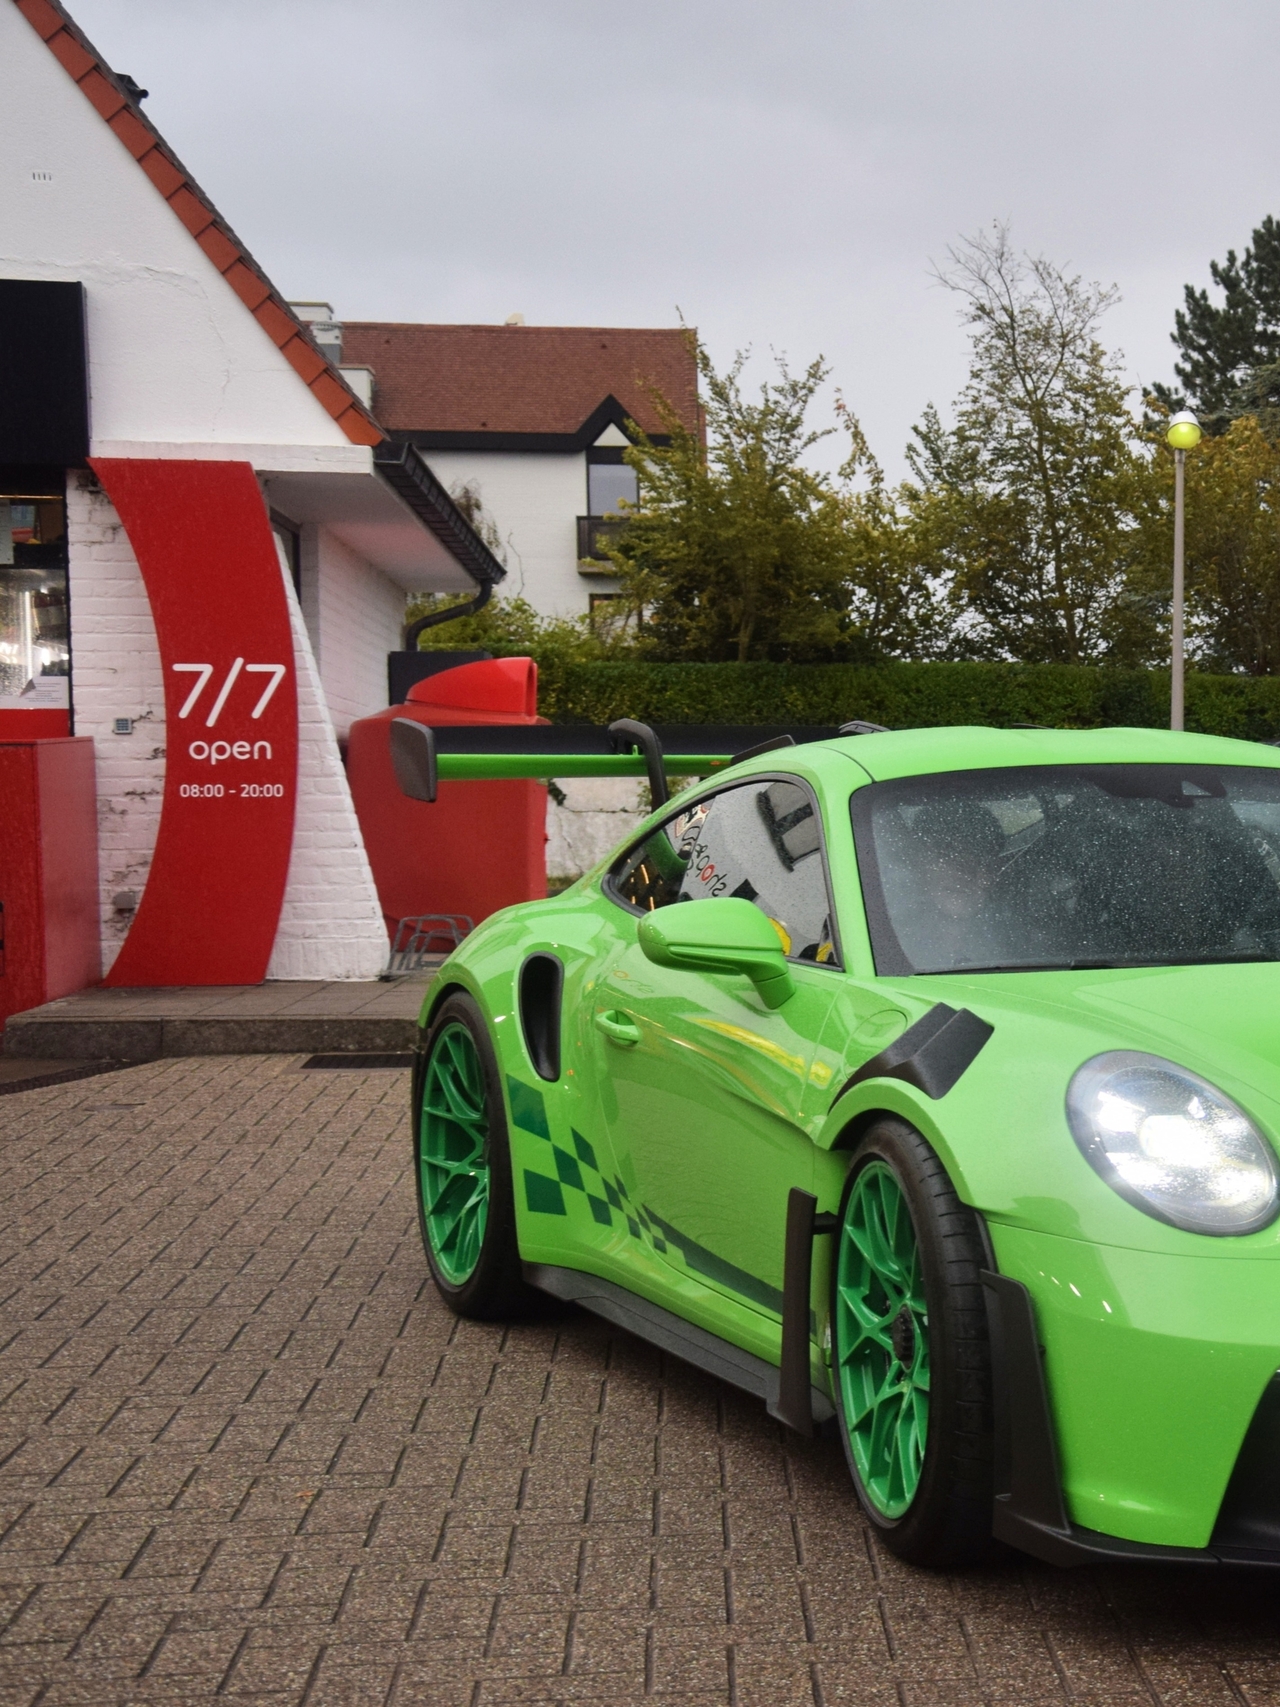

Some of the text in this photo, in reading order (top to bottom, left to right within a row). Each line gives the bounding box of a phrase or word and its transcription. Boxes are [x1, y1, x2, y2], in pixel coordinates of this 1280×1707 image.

[172, 657, 286, 728] 7/7
[188, 740, 273, 765] open
[180, 784, 225, 798] 08:00
[240, 784, 285, 798] 20:00
